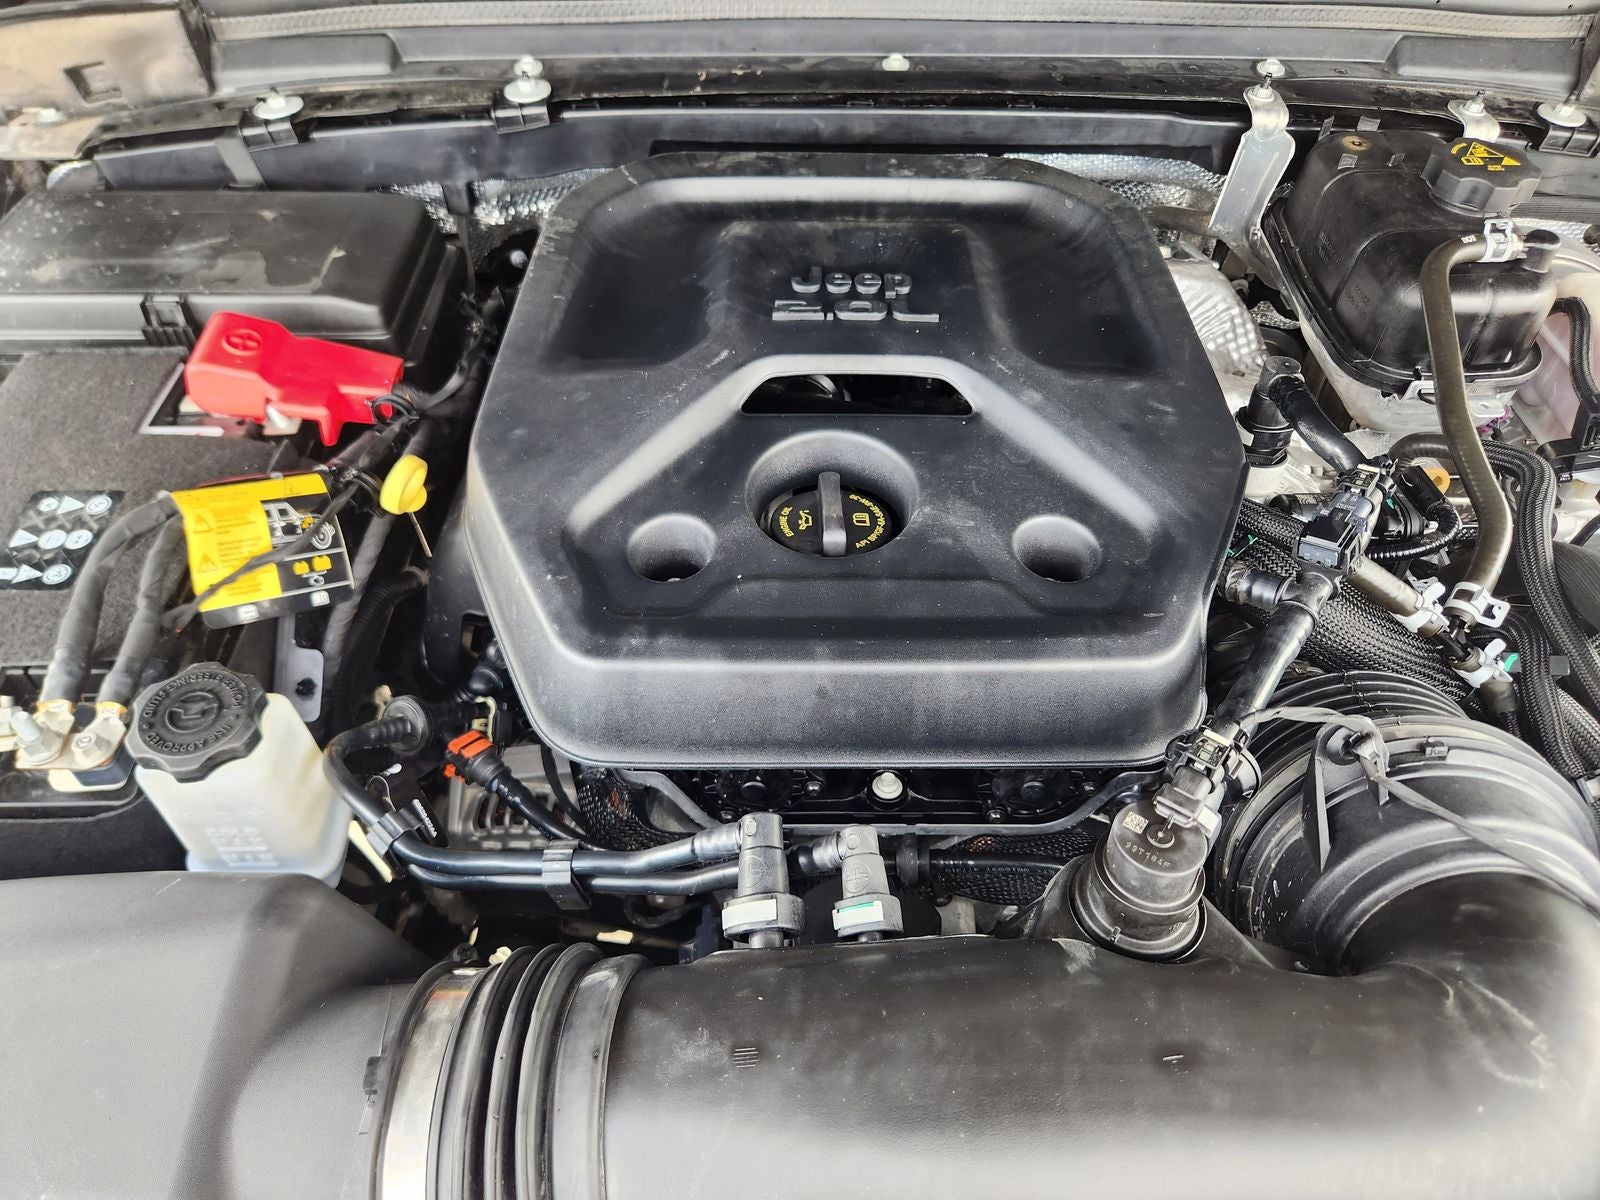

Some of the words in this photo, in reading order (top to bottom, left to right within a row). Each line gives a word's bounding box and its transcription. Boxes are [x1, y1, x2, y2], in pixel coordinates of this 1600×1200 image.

[791, 266, 912, 299] Jeep
[772, 300, 940, 322] 2.0L
[781, 506, 793, 516] OIL
[779, 515, 795, 537] ENGINE
[855, 539, 870, 548] API
[166, 672, 224, 692] STEERING
[143, 690, 168, 718] FLUID
[146, 732, 205, 752] APPROVED
